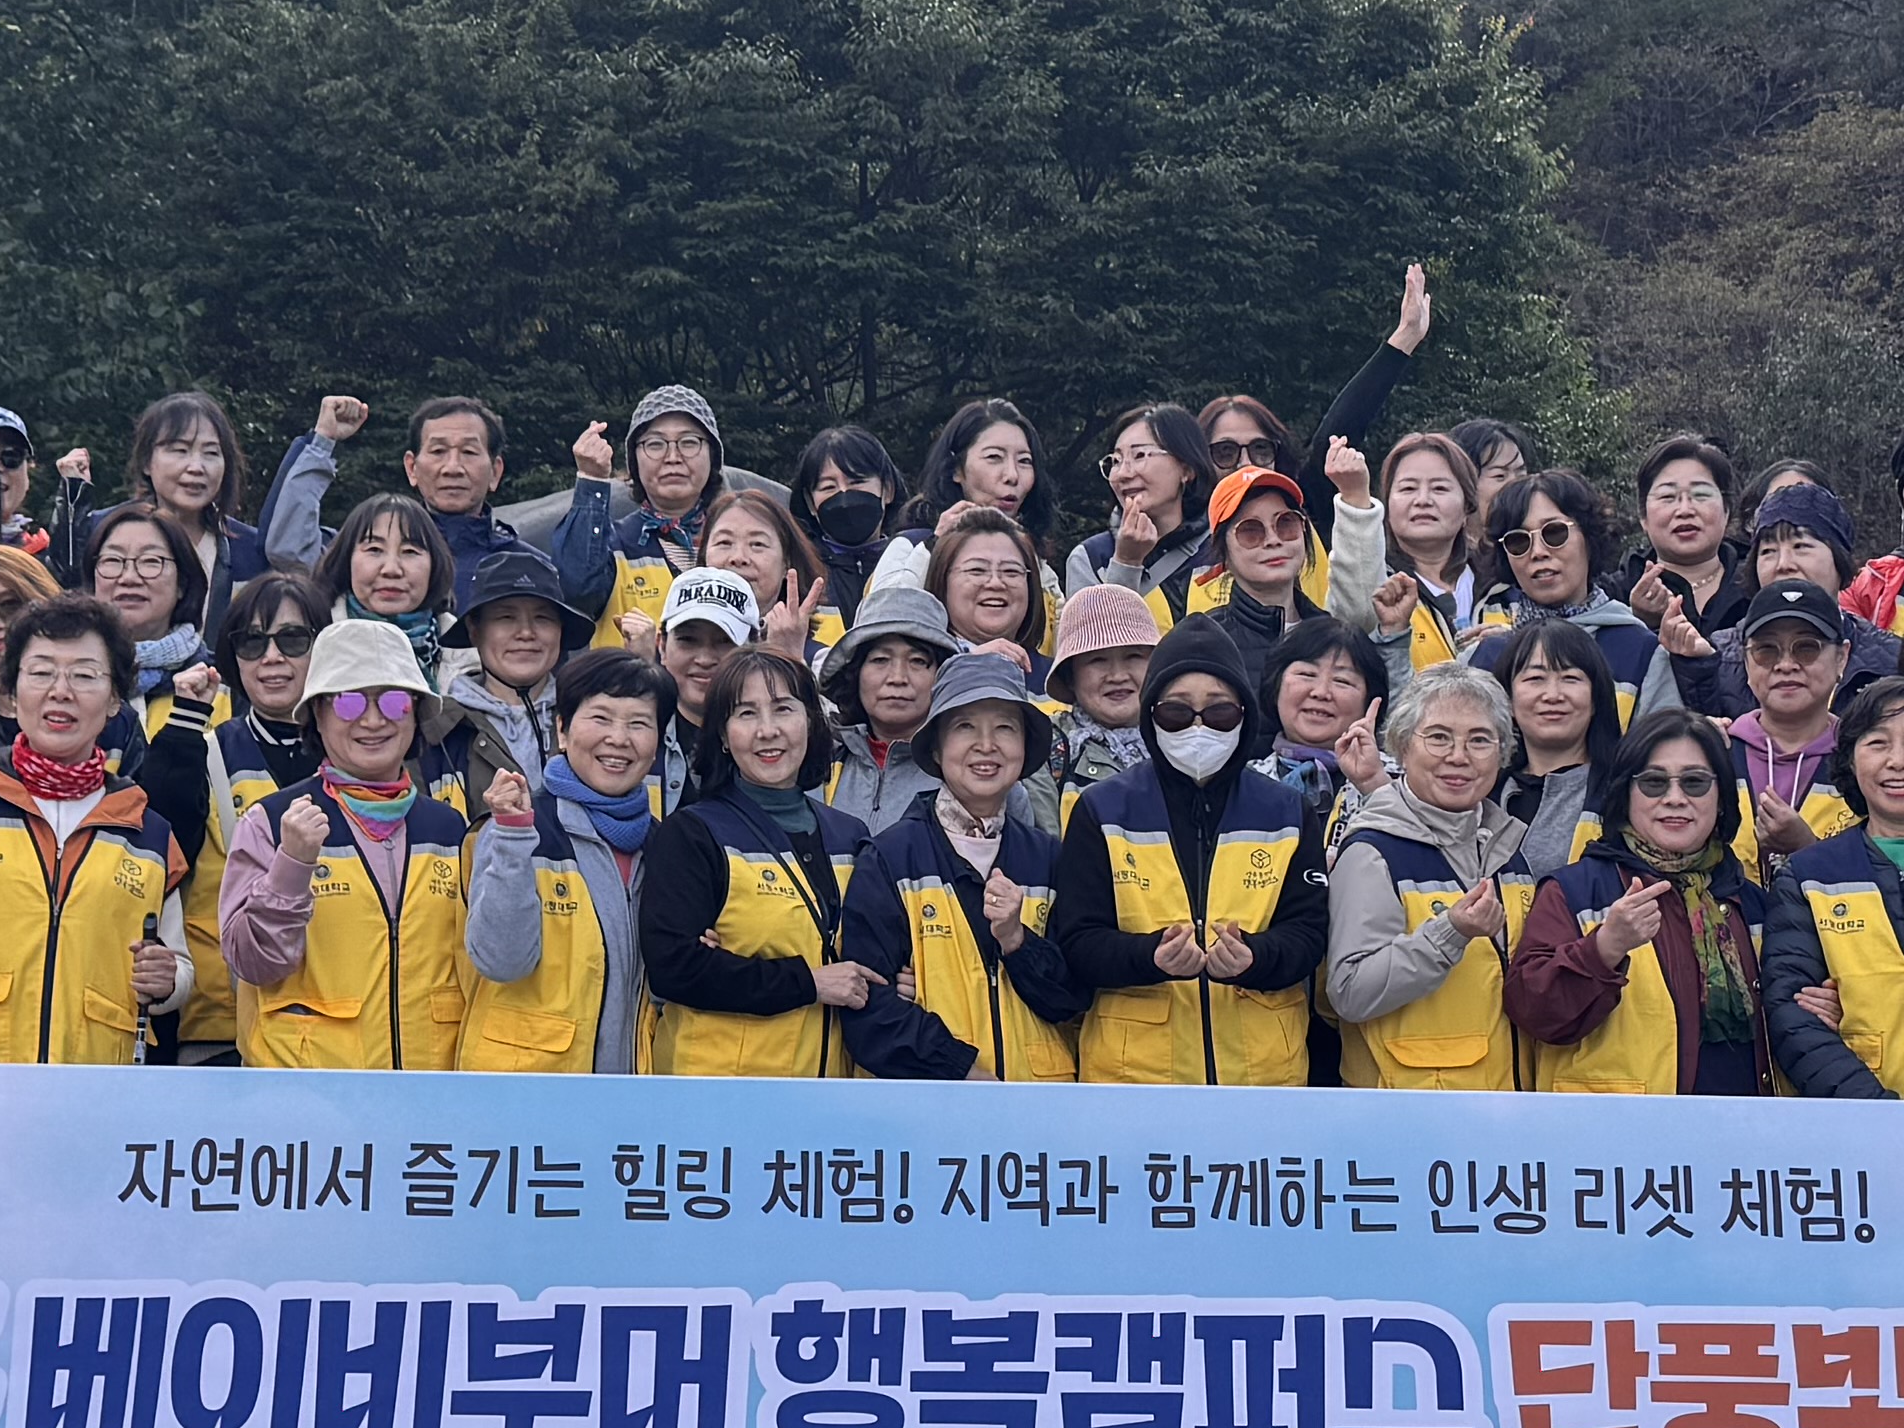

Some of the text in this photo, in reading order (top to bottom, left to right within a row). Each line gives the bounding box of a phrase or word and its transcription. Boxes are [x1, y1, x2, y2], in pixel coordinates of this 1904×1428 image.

[118, 1137, 1876, 1244] 자연에서 즐기는 힐링 체험! 지역과 함께하는 인생 리셋 체험!
